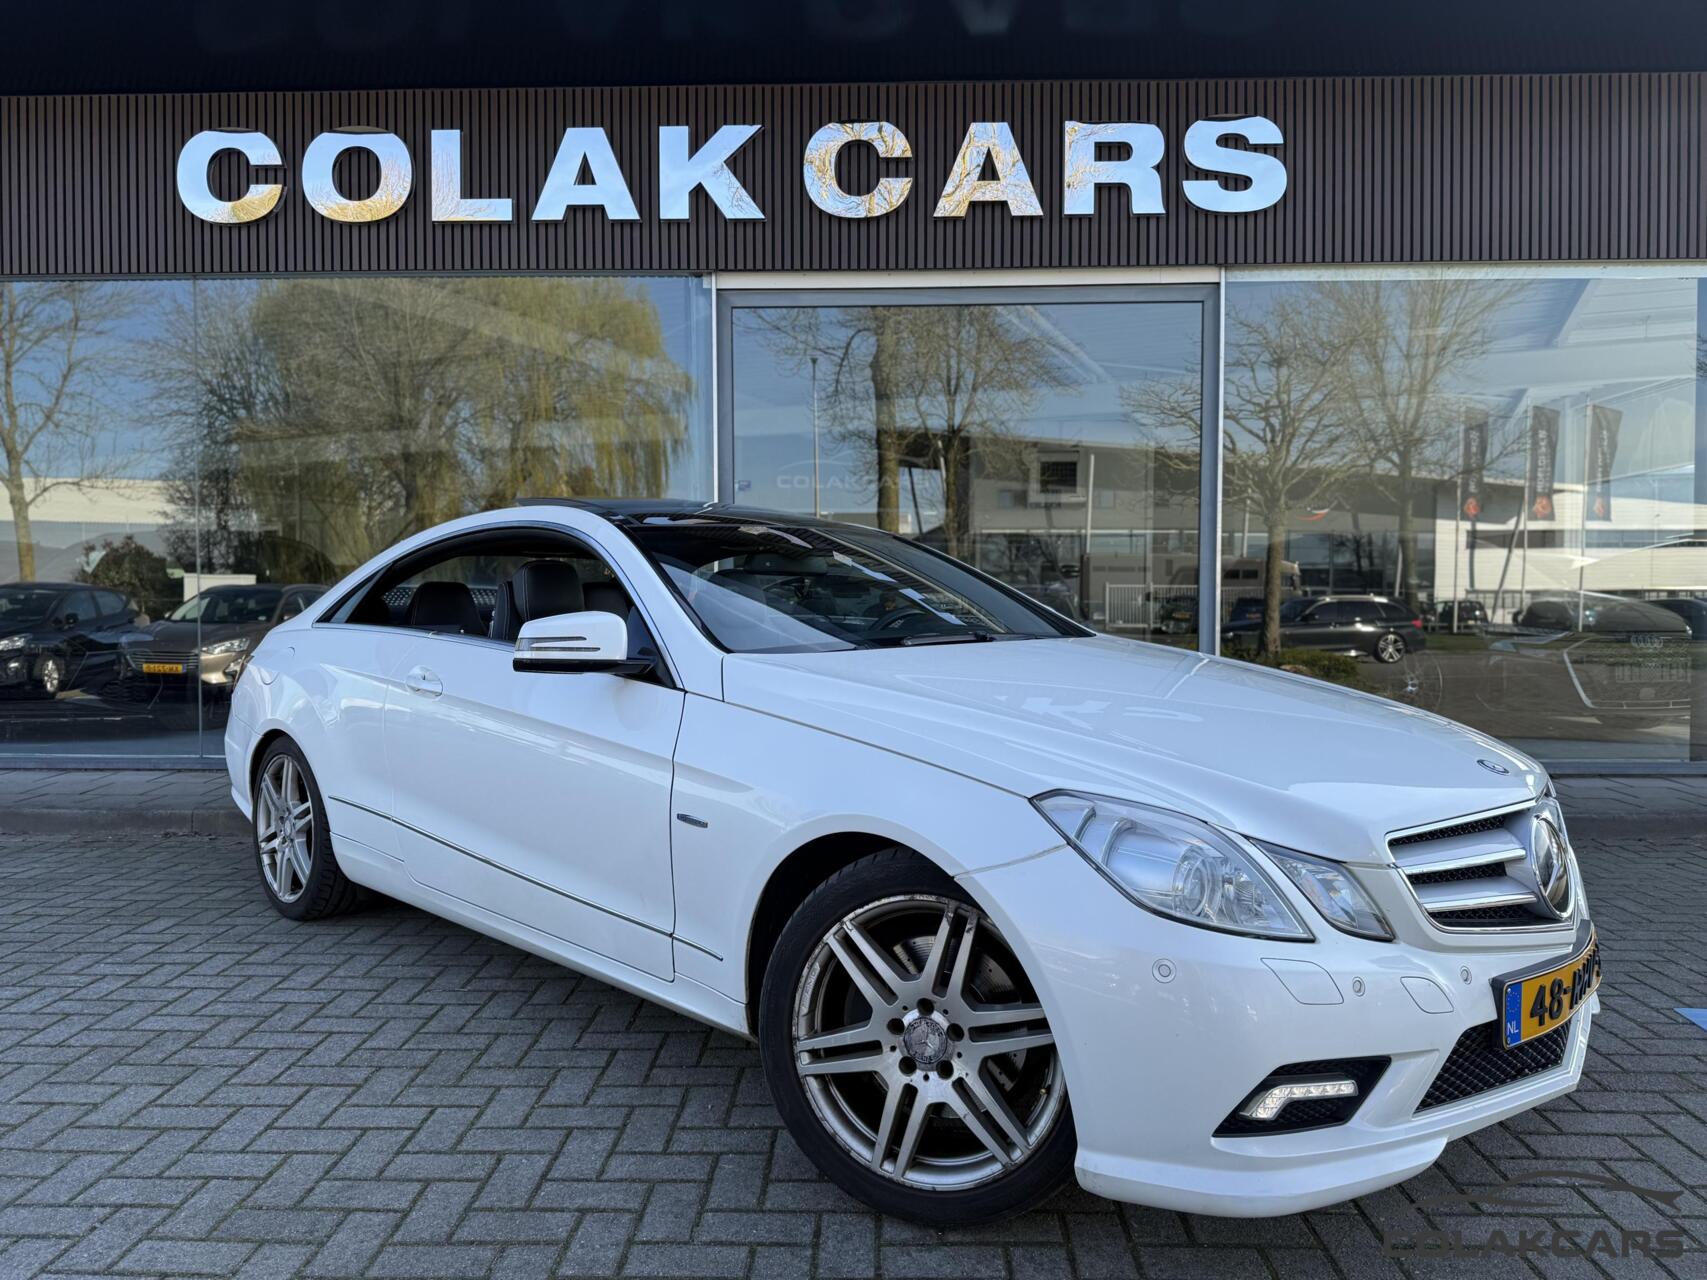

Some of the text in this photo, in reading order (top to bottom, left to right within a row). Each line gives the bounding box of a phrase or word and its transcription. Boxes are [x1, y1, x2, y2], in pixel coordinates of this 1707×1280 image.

[176, 115, 1288, 224] COLAK CARS
[776, 474, 929, 489] COLAKCAS
[1507, 1022, 1519, 1035] NL
